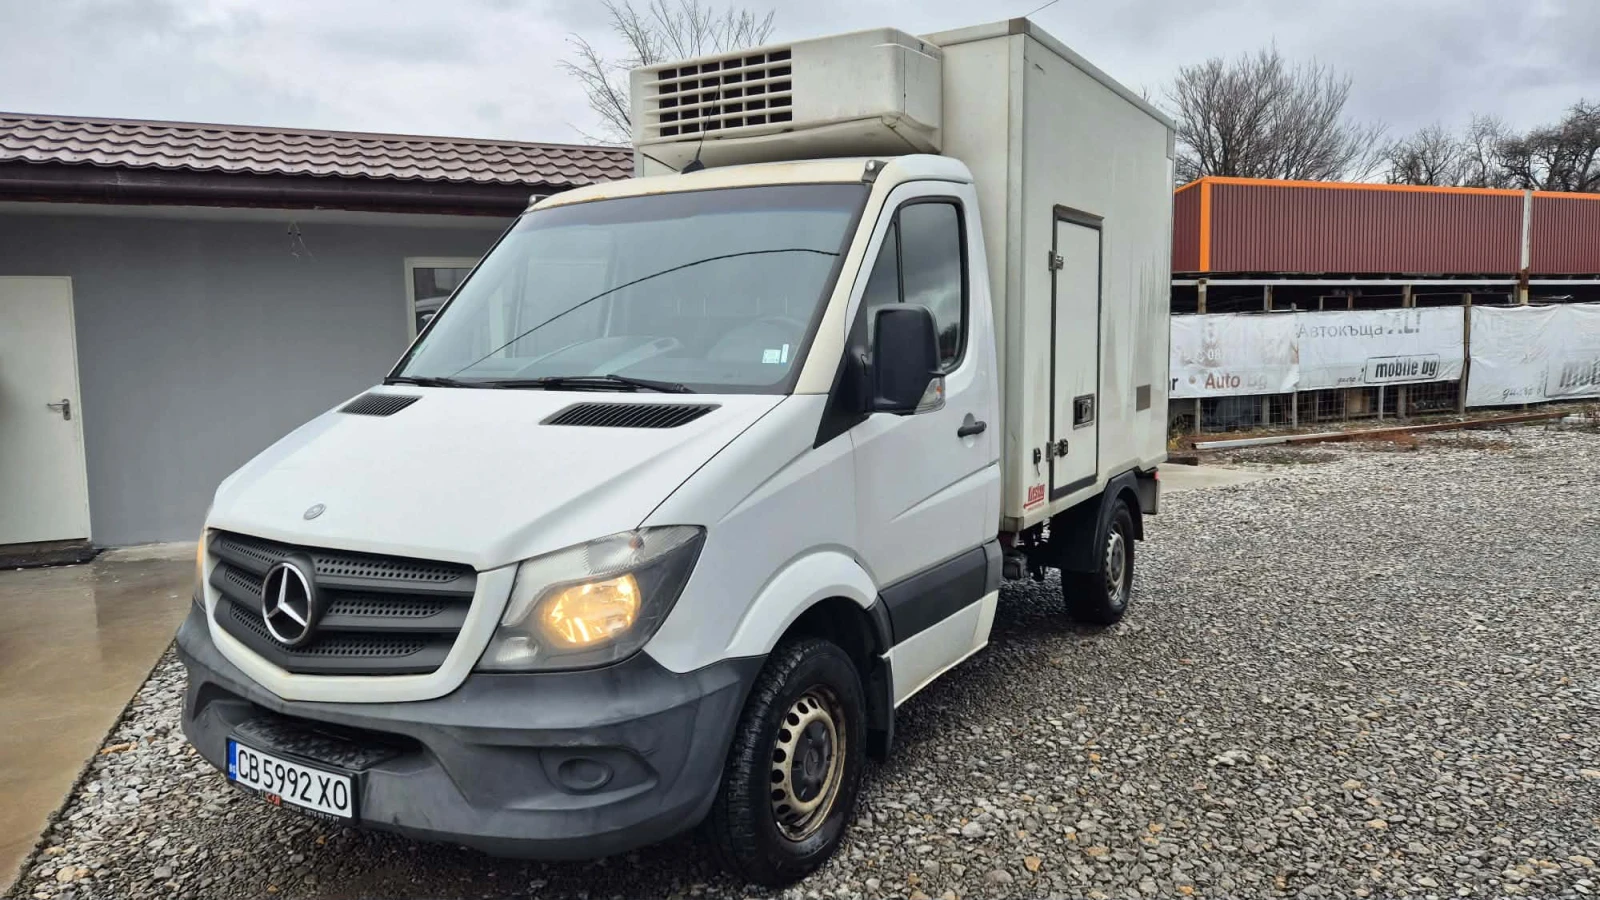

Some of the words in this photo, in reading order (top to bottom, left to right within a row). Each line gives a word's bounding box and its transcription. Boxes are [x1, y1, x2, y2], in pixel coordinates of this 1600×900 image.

[1297, 323, 1384, 339] Автокъща
[1374, 358, 1418, 378] mobile
[1204, 373, 1241, 389] Auto
